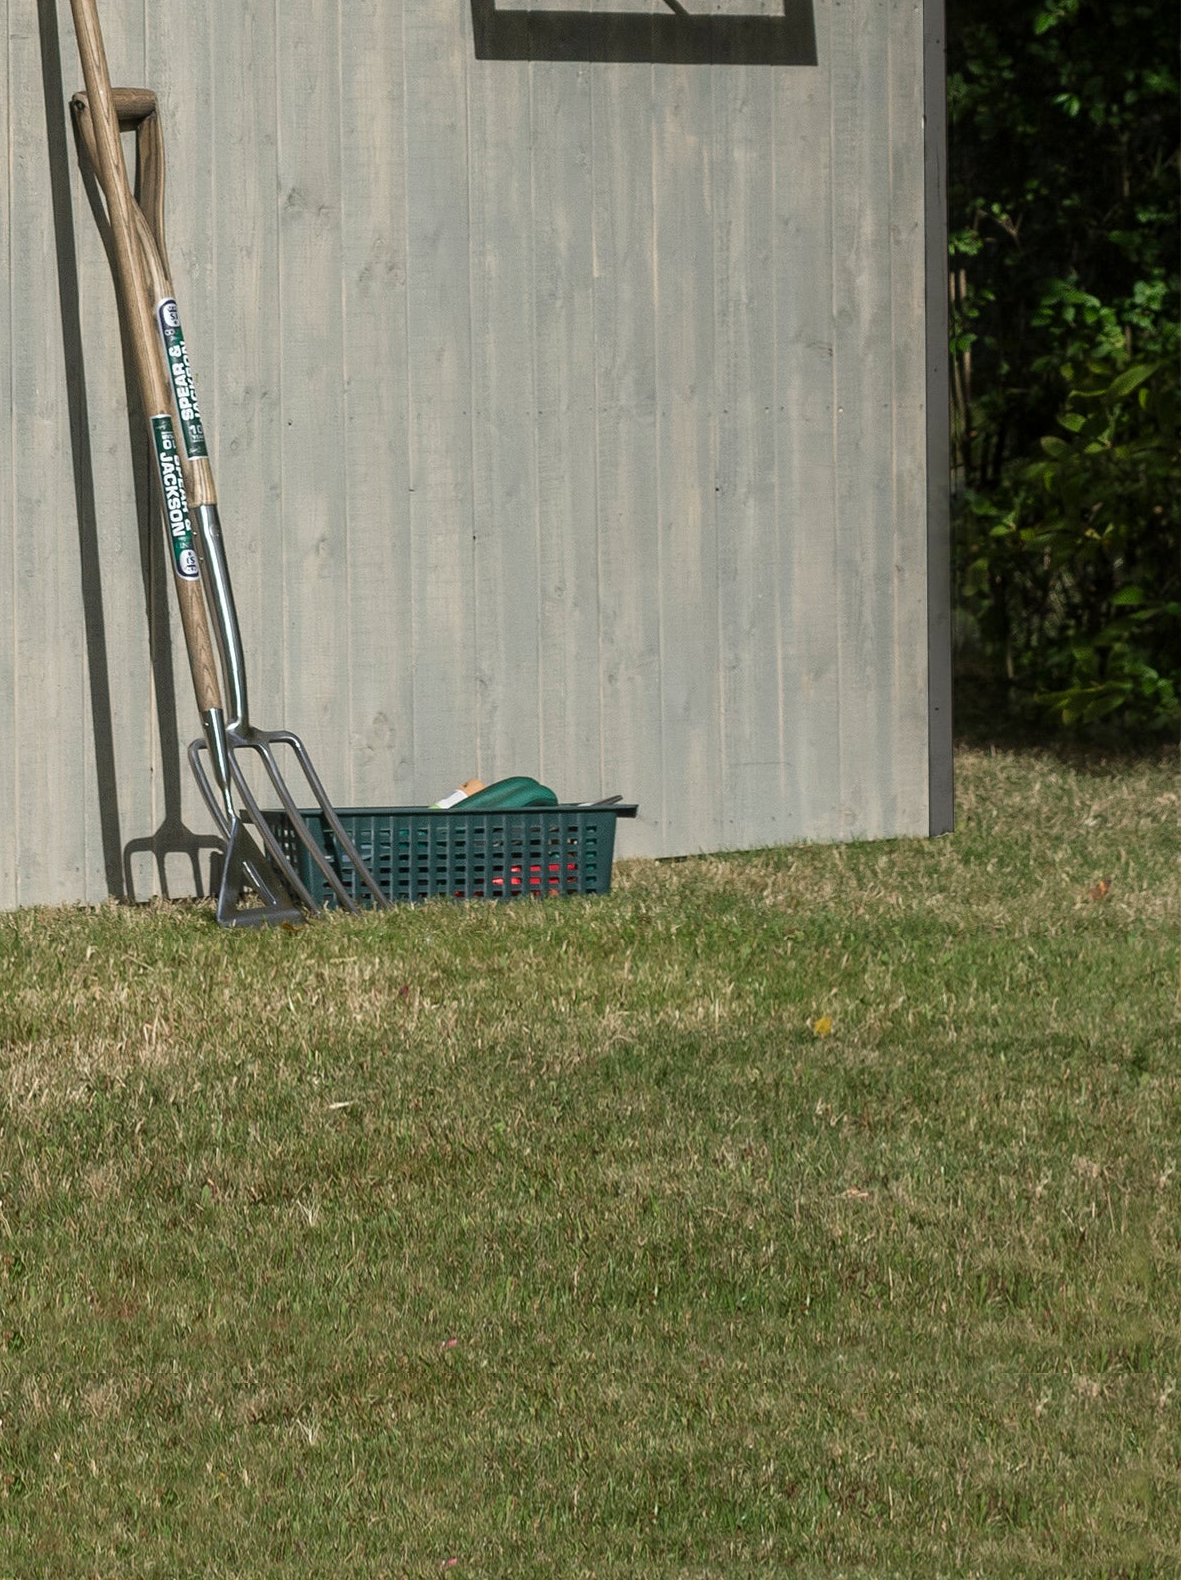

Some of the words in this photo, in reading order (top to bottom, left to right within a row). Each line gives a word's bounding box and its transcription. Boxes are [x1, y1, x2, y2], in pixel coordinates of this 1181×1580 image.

[168, 345, 182, 358] &
[172, 362, 194, 421] SPEAR
[159, 451, 186, 537] JACKSON
